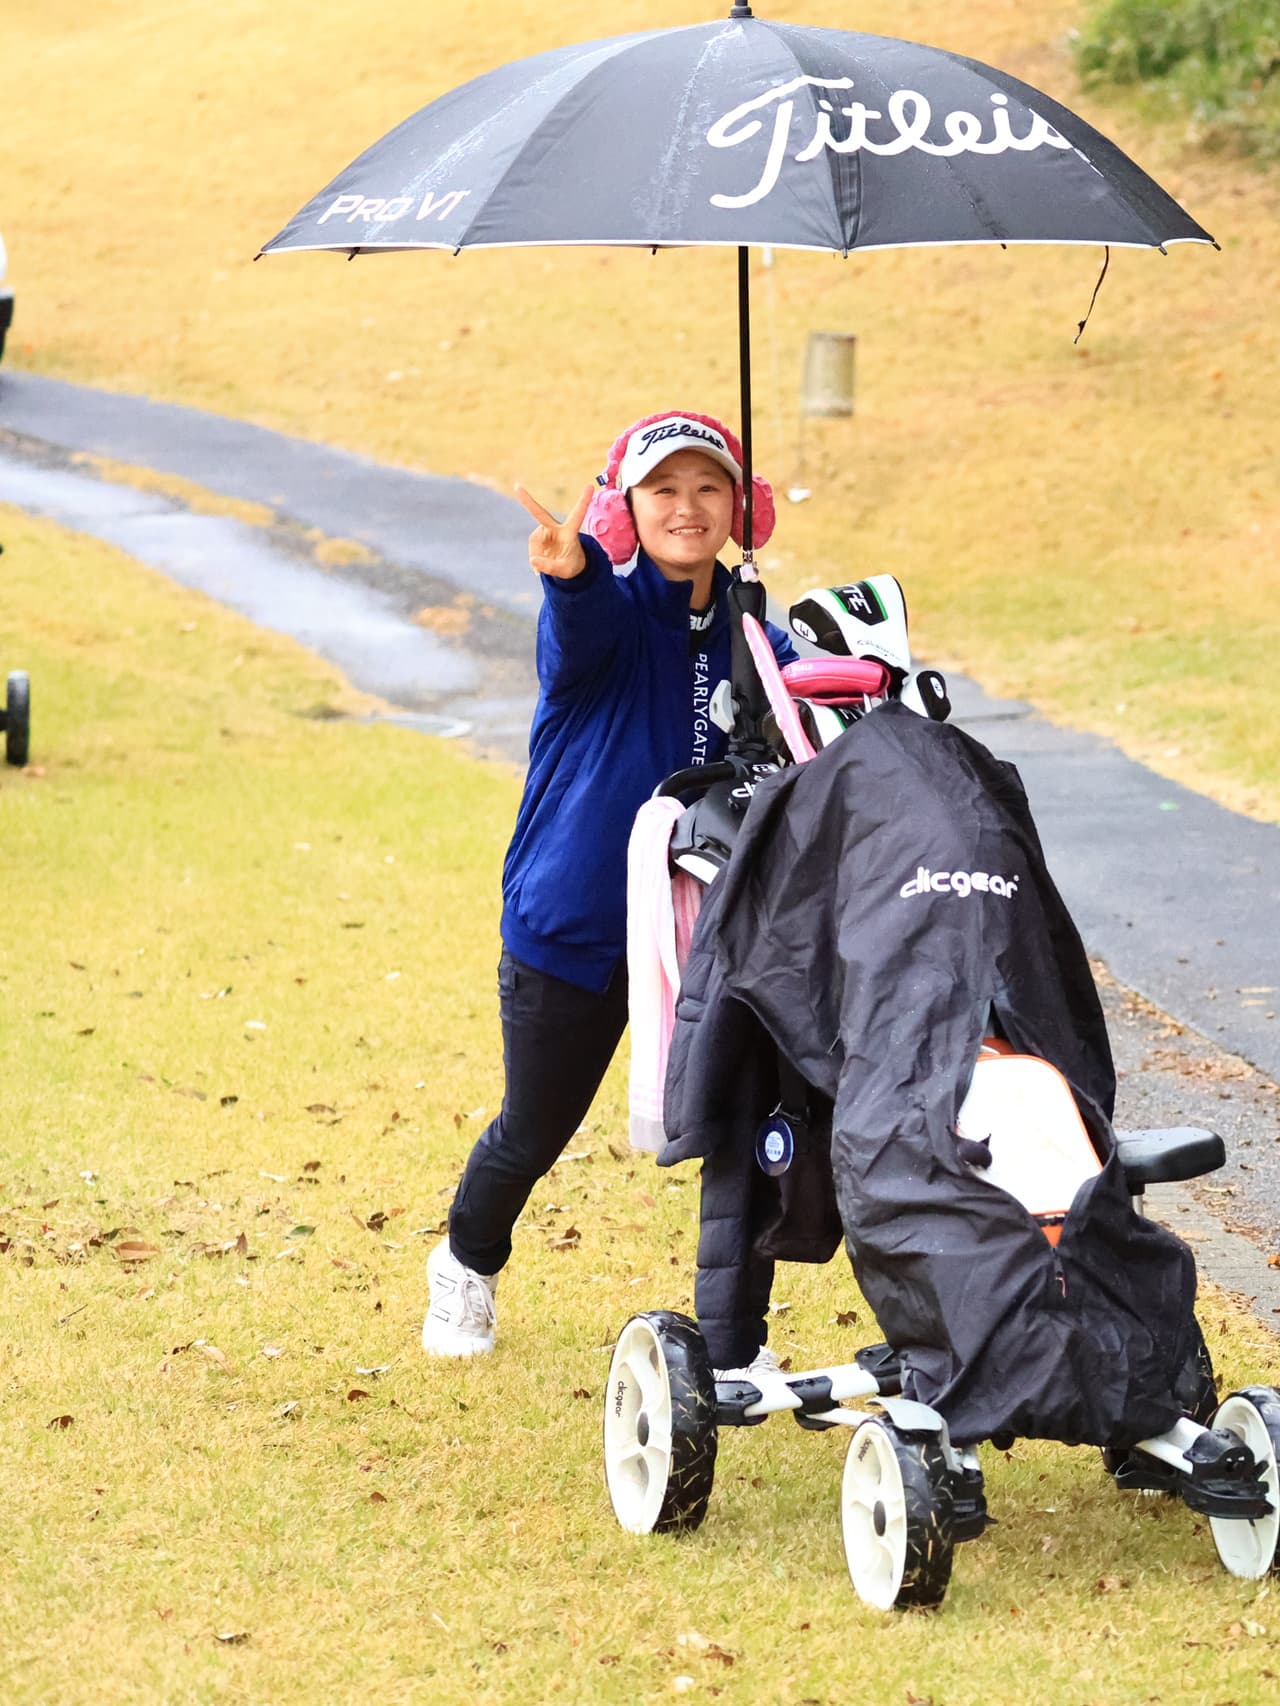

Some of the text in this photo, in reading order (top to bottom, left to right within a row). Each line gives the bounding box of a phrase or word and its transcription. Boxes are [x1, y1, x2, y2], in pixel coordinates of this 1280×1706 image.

[638, 422, 724, 456] Titleist
[691, 652, 709, 765] PEARLYGATE
[900, 866, 1018, 899] clicgear
